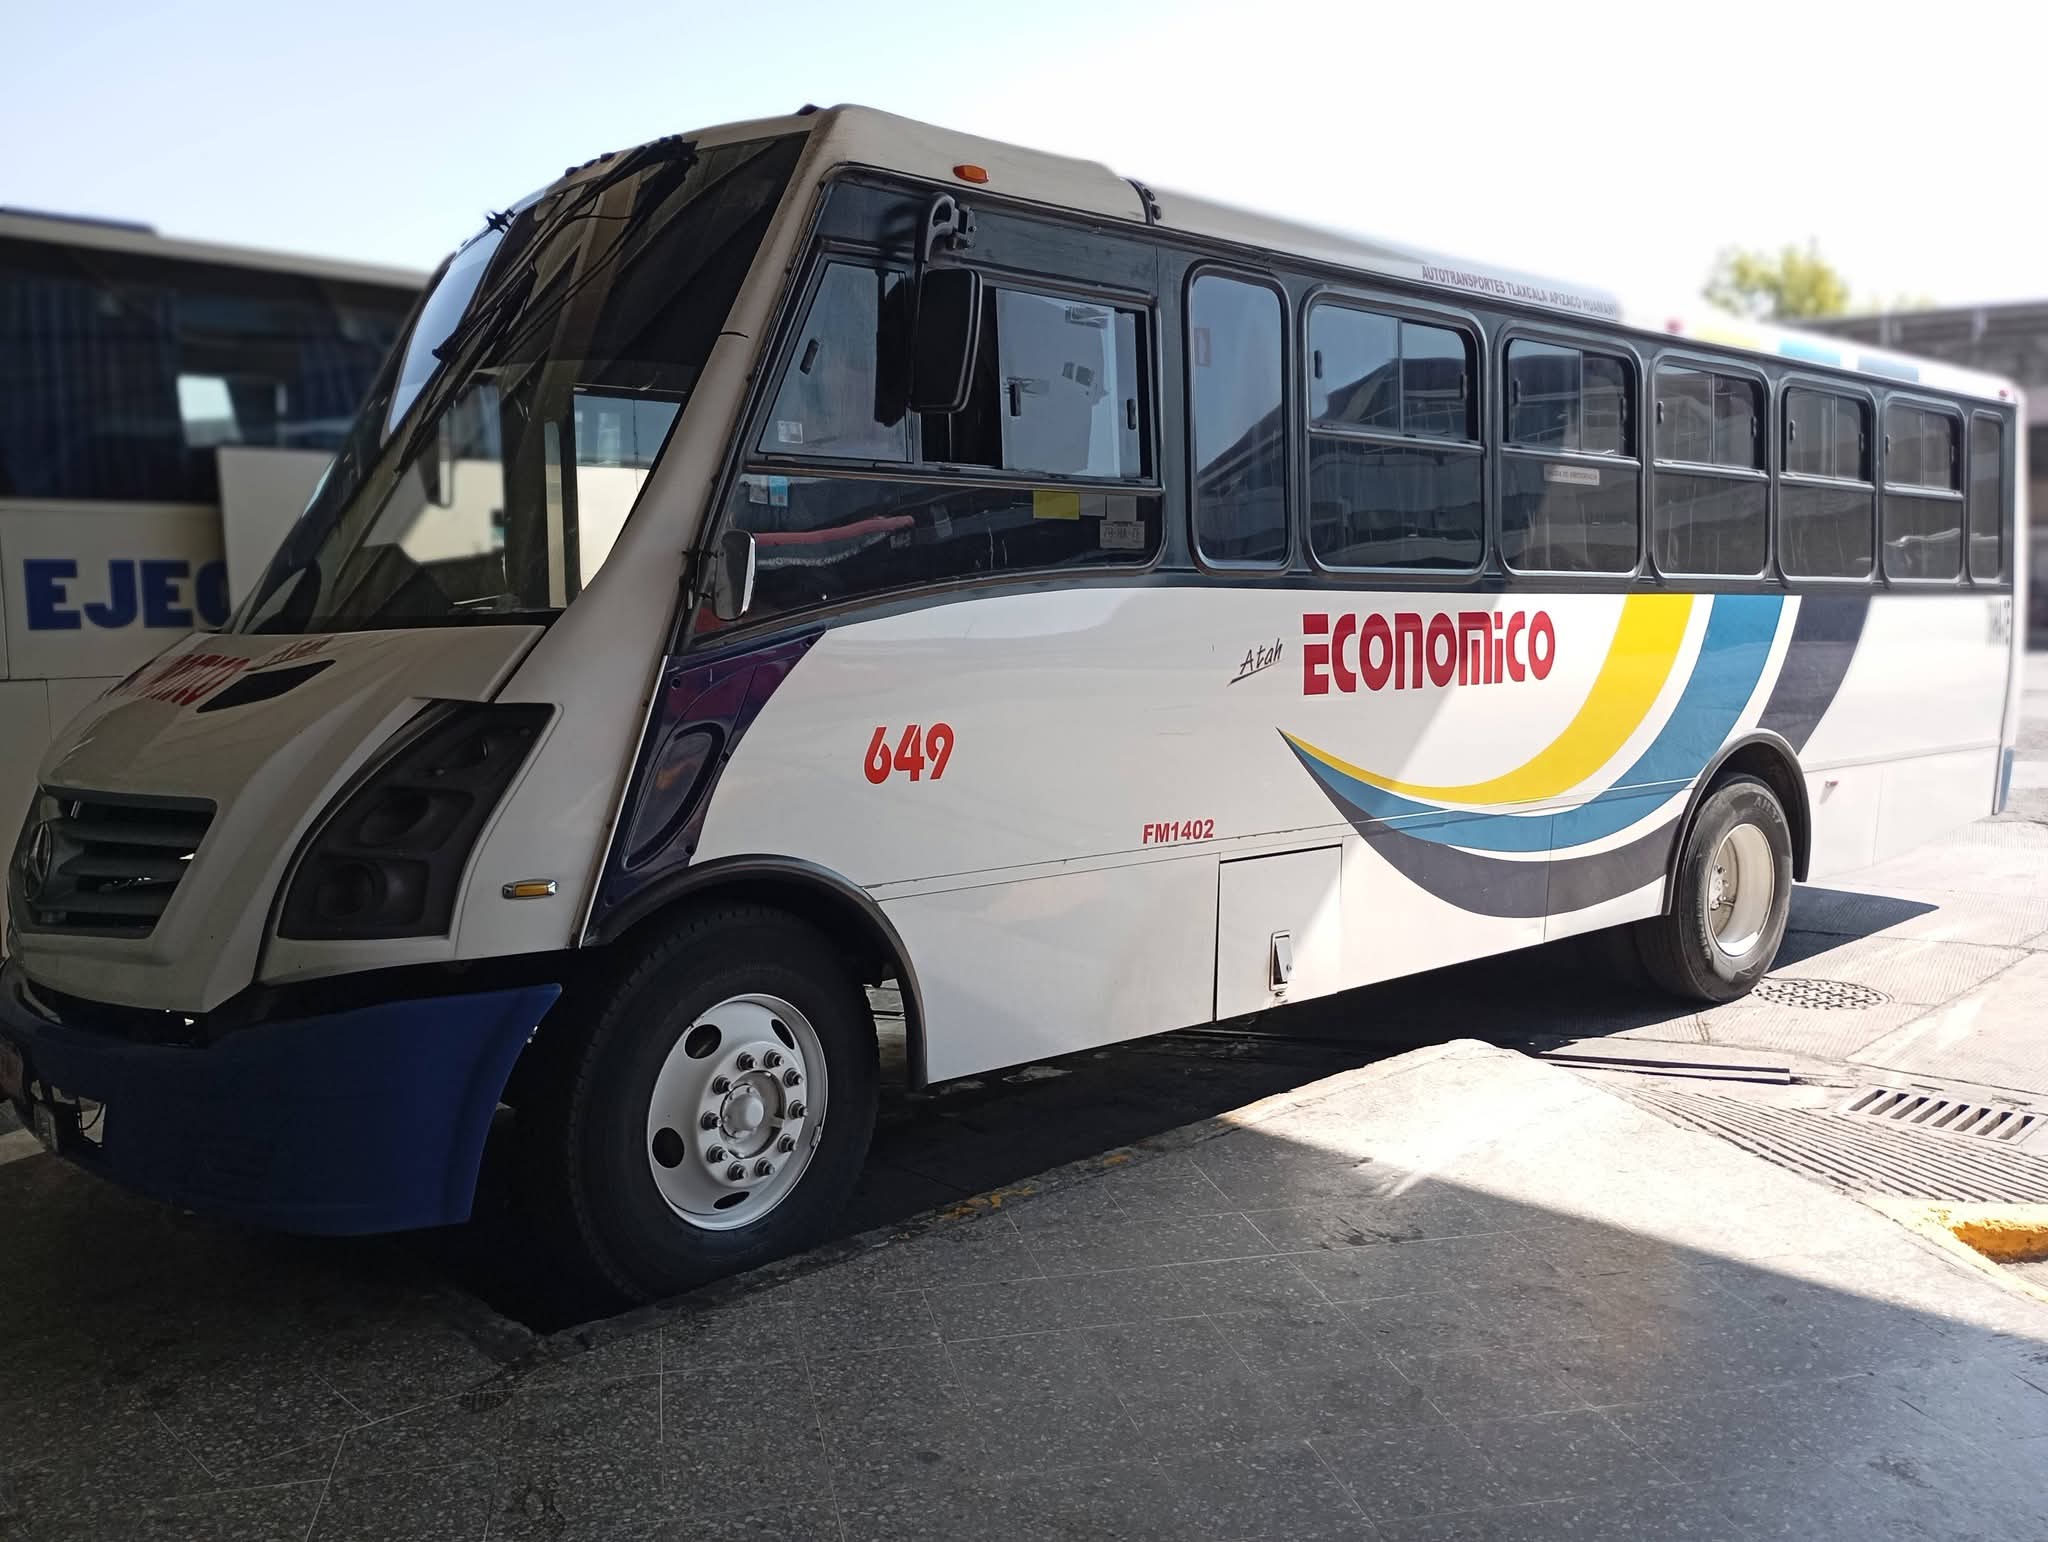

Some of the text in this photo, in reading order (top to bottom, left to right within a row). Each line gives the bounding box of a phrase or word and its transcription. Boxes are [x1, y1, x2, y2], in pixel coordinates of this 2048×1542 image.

[1422, 265, 1505, 294] AUTOTRANSPORTES
[1506, 282, 1547, 302] TLAXCALA
[1549, 290, 1582, 309] APIZACO
[863, 722, 955, 785] 649
[1142, 818, 1215, 844] FM1402
